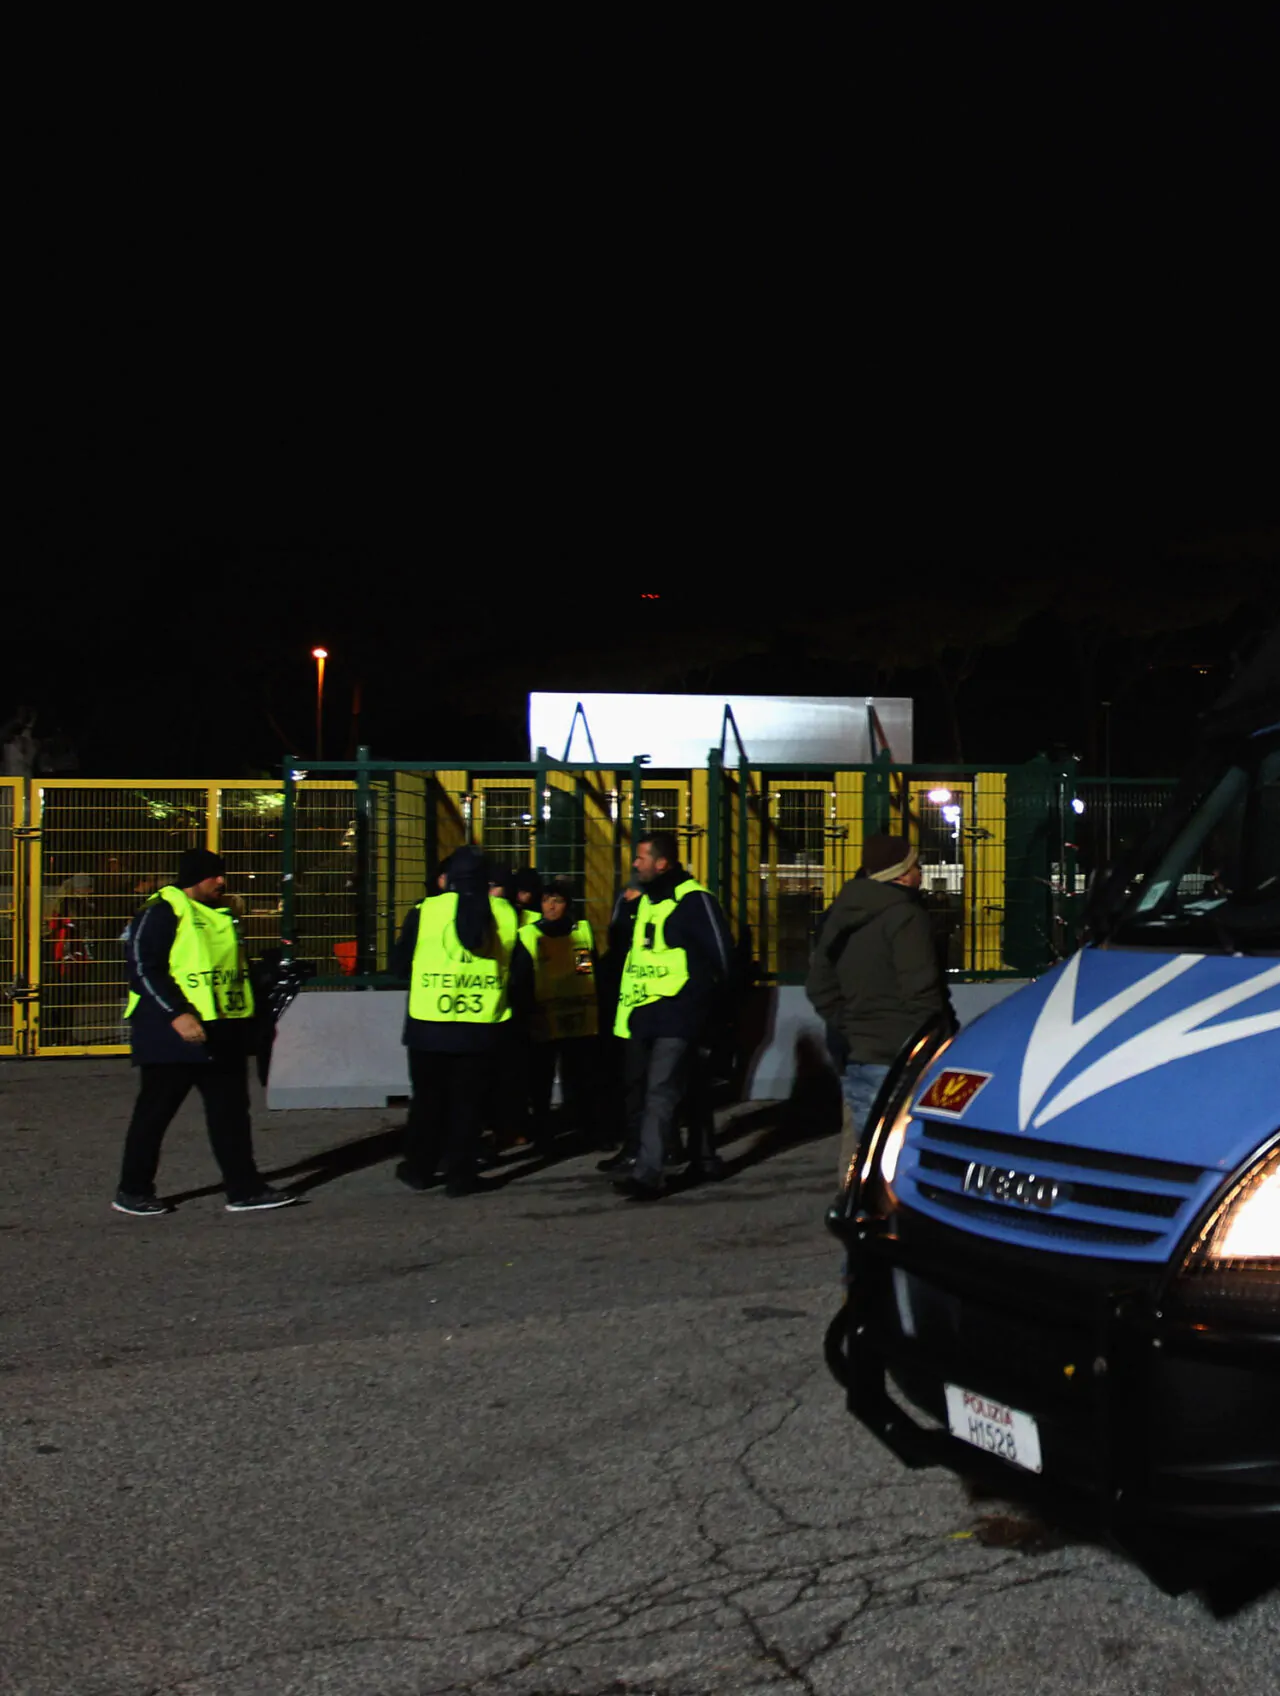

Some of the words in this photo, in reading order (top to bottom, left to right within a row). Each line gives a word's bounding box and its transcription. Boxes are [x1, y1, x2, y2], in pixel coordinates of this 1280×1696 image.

[421, 973, 507, 990] STEWARD
[437, 994, 484, 1014] 063
[964, 1161, 1061, 1208] IVECO
[963, 1391, 1013, 1427] POLIZIA
[967, 1416, 1017, 1461] H1528
